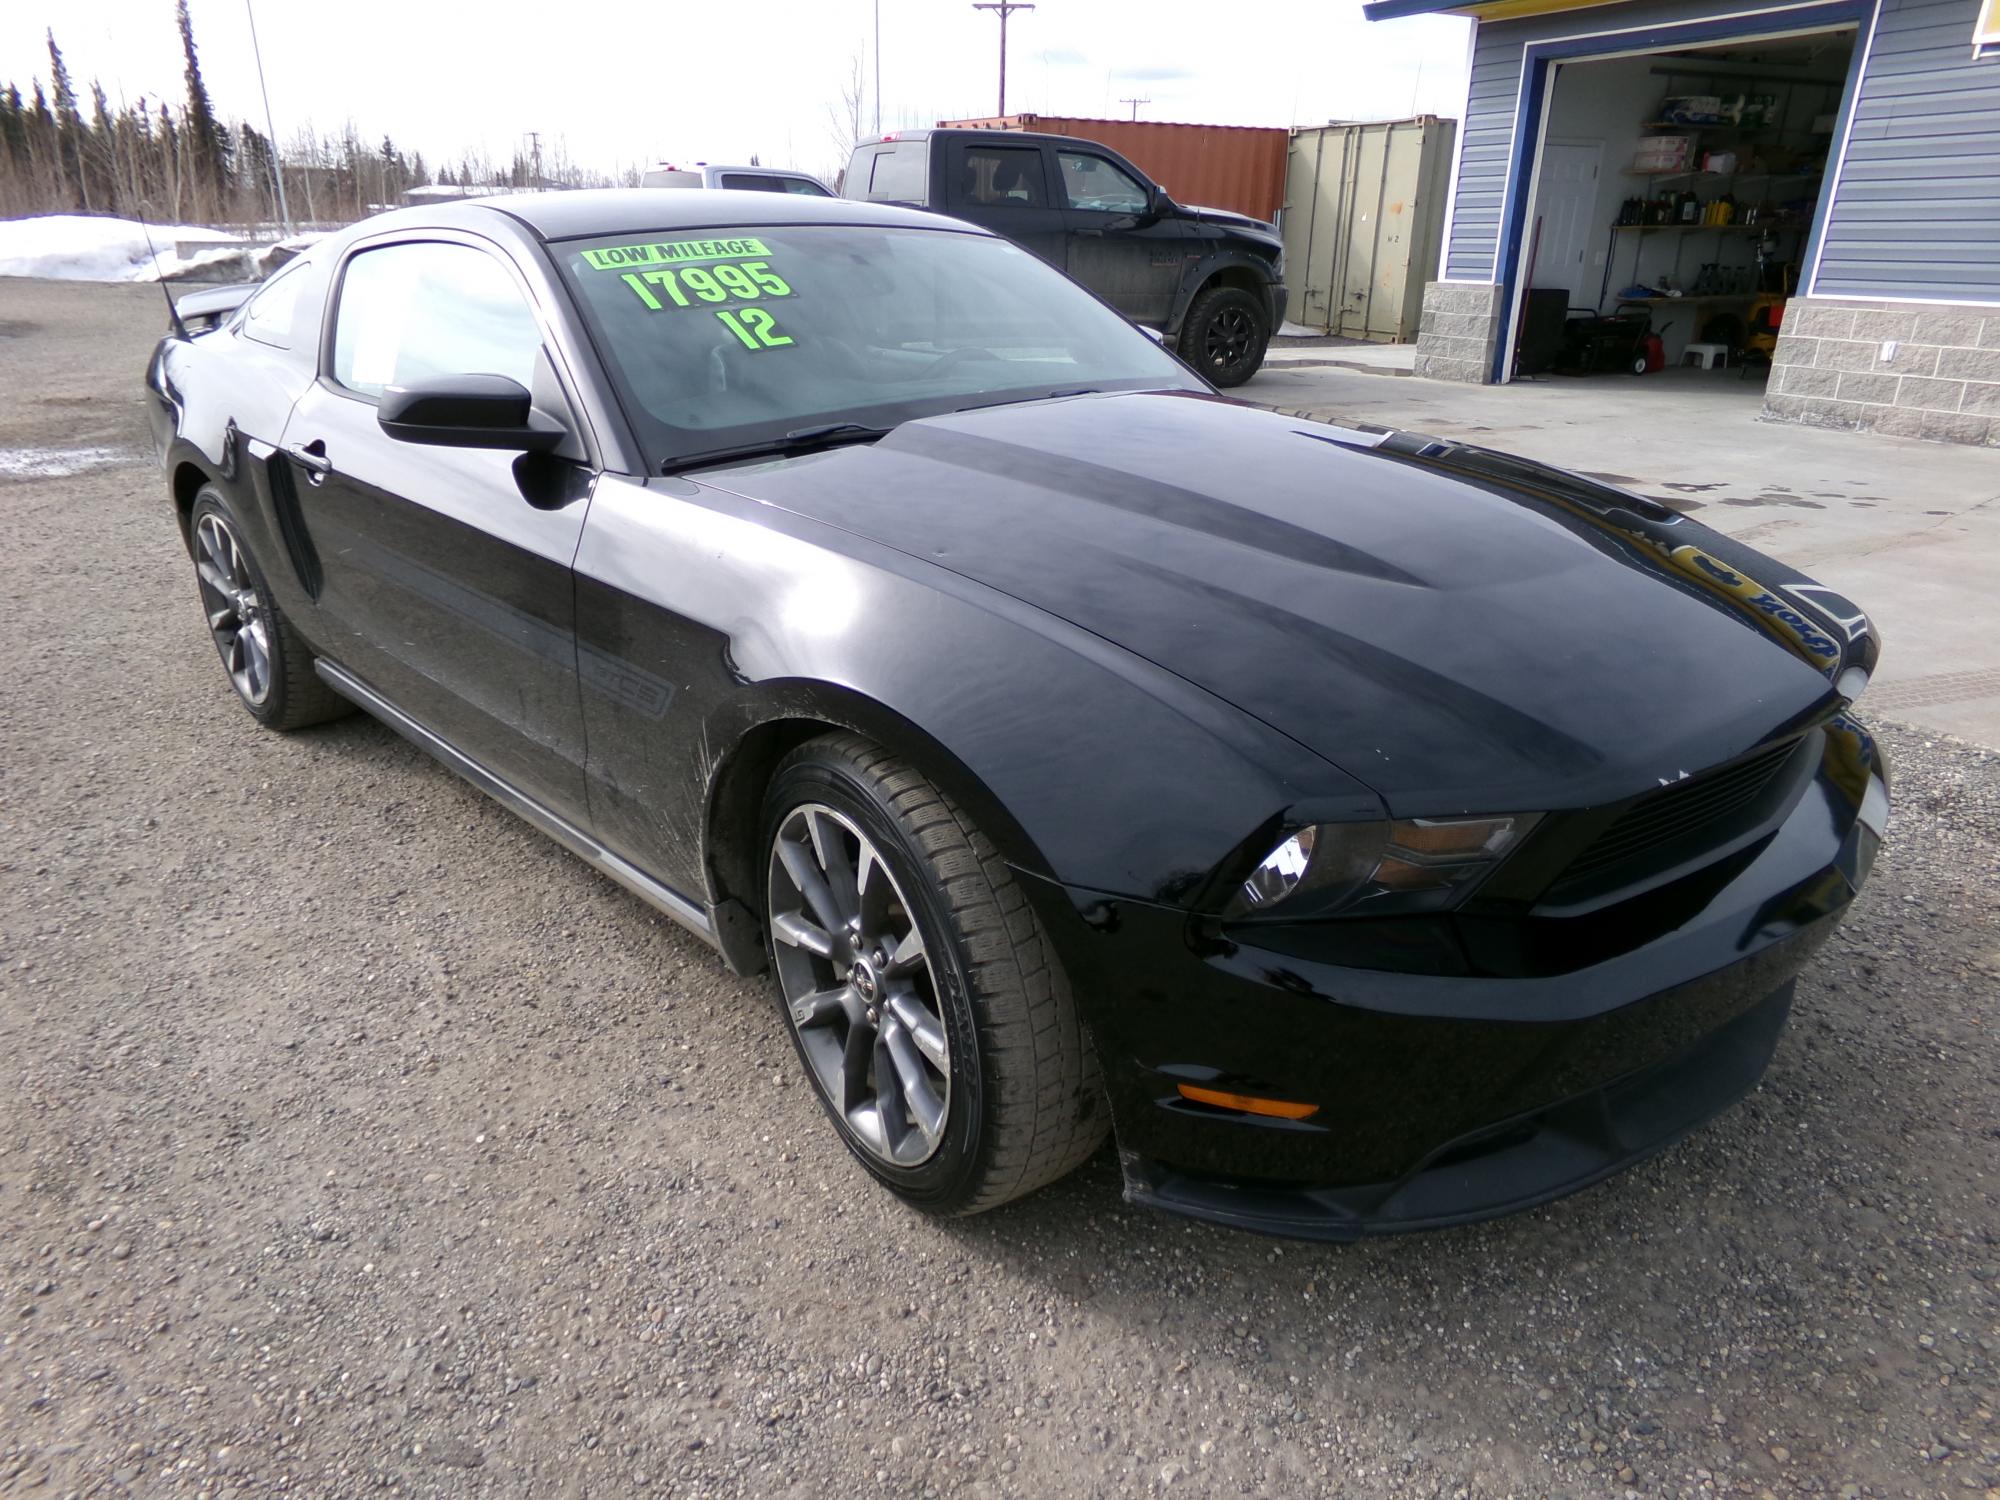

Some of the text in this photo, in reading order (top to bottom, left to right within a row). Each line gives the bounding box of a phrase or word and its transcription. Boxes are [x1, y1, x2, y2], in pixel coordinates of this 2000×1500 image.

[592, 240, 757, 266] LOW MILEAGE
[621, 262, 791, 310] 17995
[716, 308, 794, 350] 12
